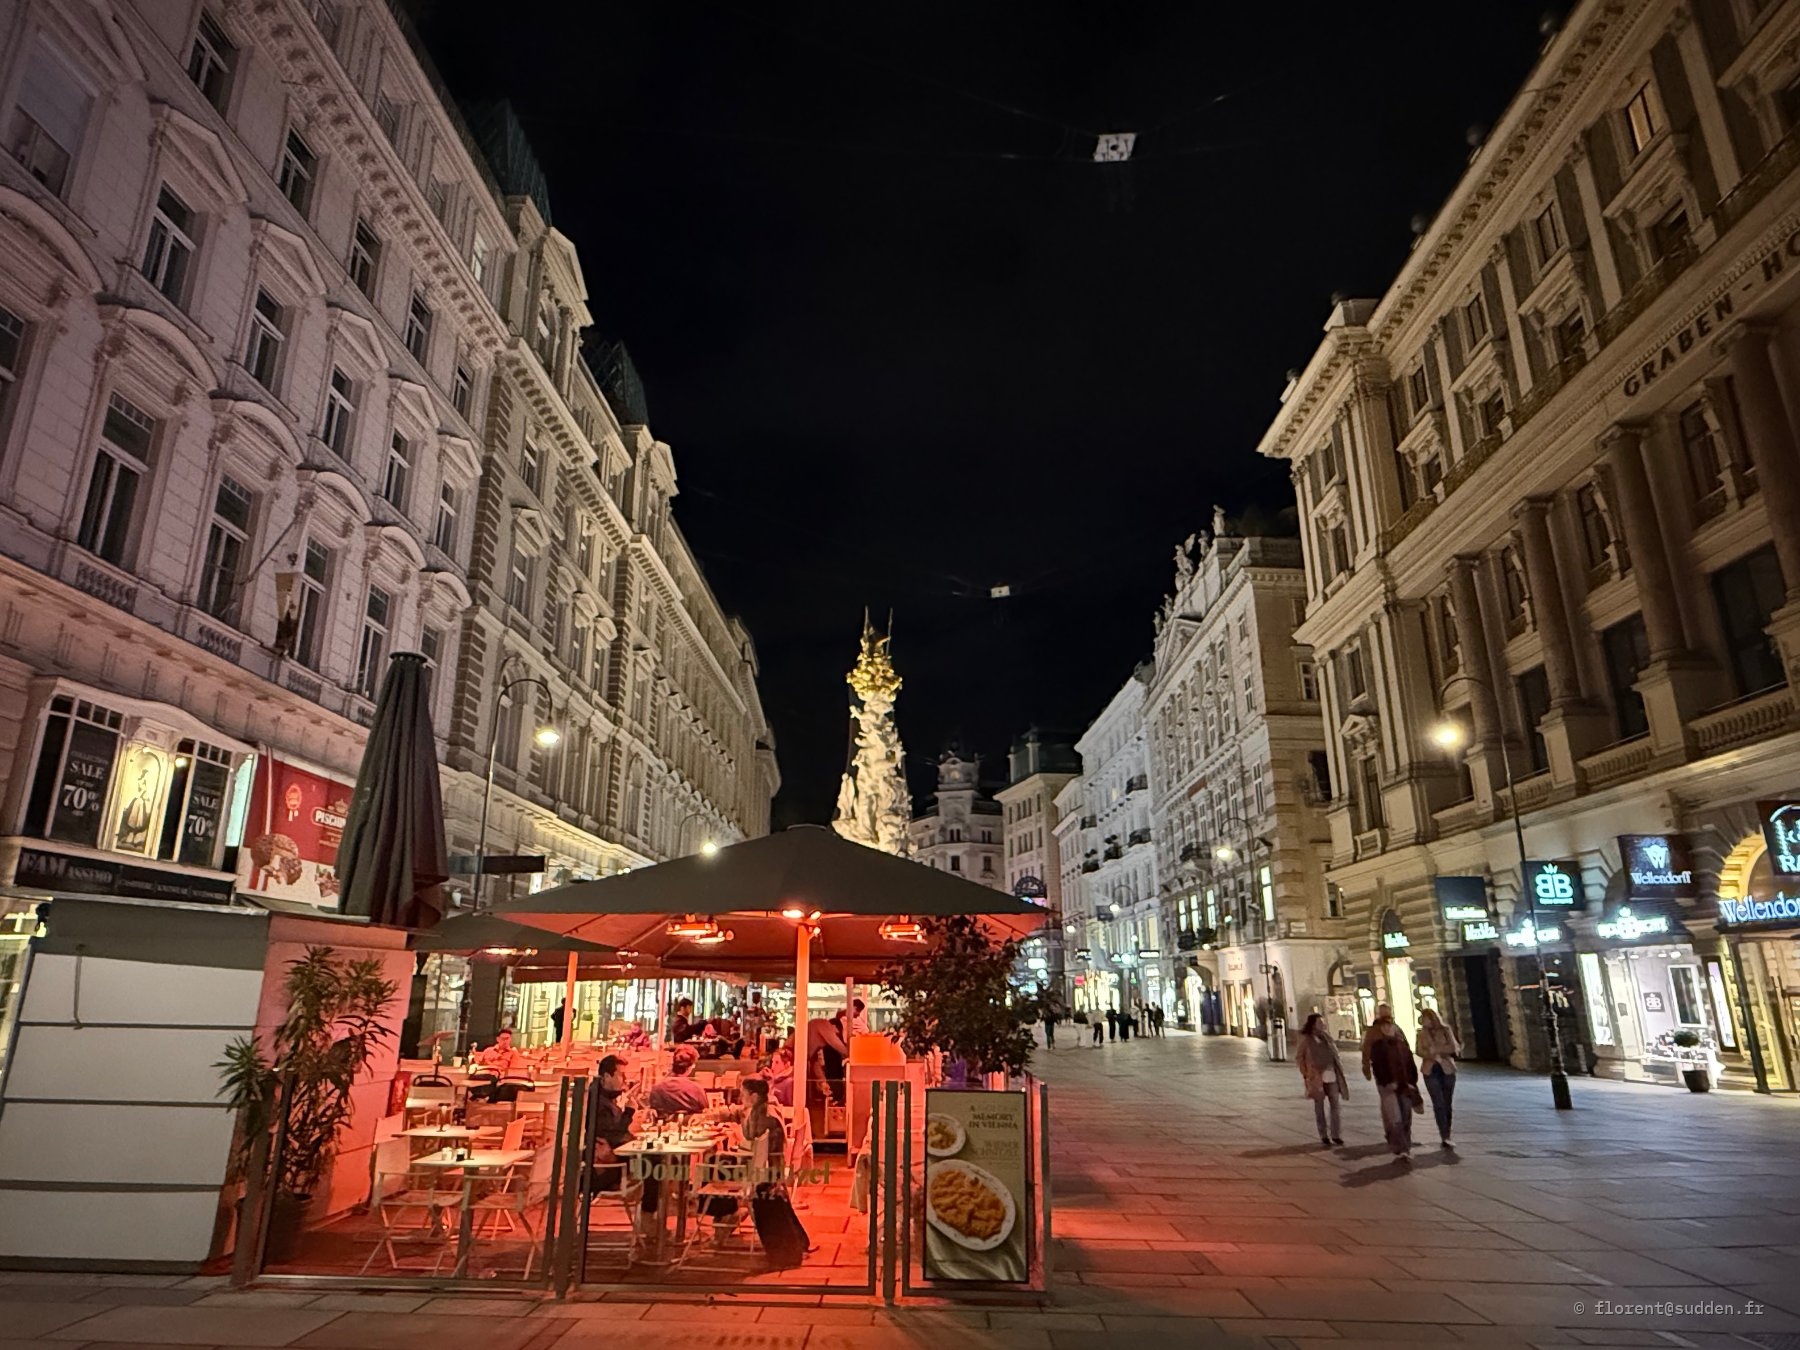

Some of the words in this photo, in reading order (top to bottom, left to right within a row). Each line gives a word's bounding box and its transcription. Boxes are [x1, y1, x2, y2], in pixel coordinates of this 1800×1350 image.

[1624, 293, 1733, 396] GRABEN
[70, 760, 104, 780] SALE
[63, 784, 100, 811] 70%
[192, 795, 219, 809] SALE
[1631, 870, 1692, 885] Wellendorff
[972, 1113, 1013, 1121] MEMORY
[981, 1121, 1018, 1129] VIENNA
